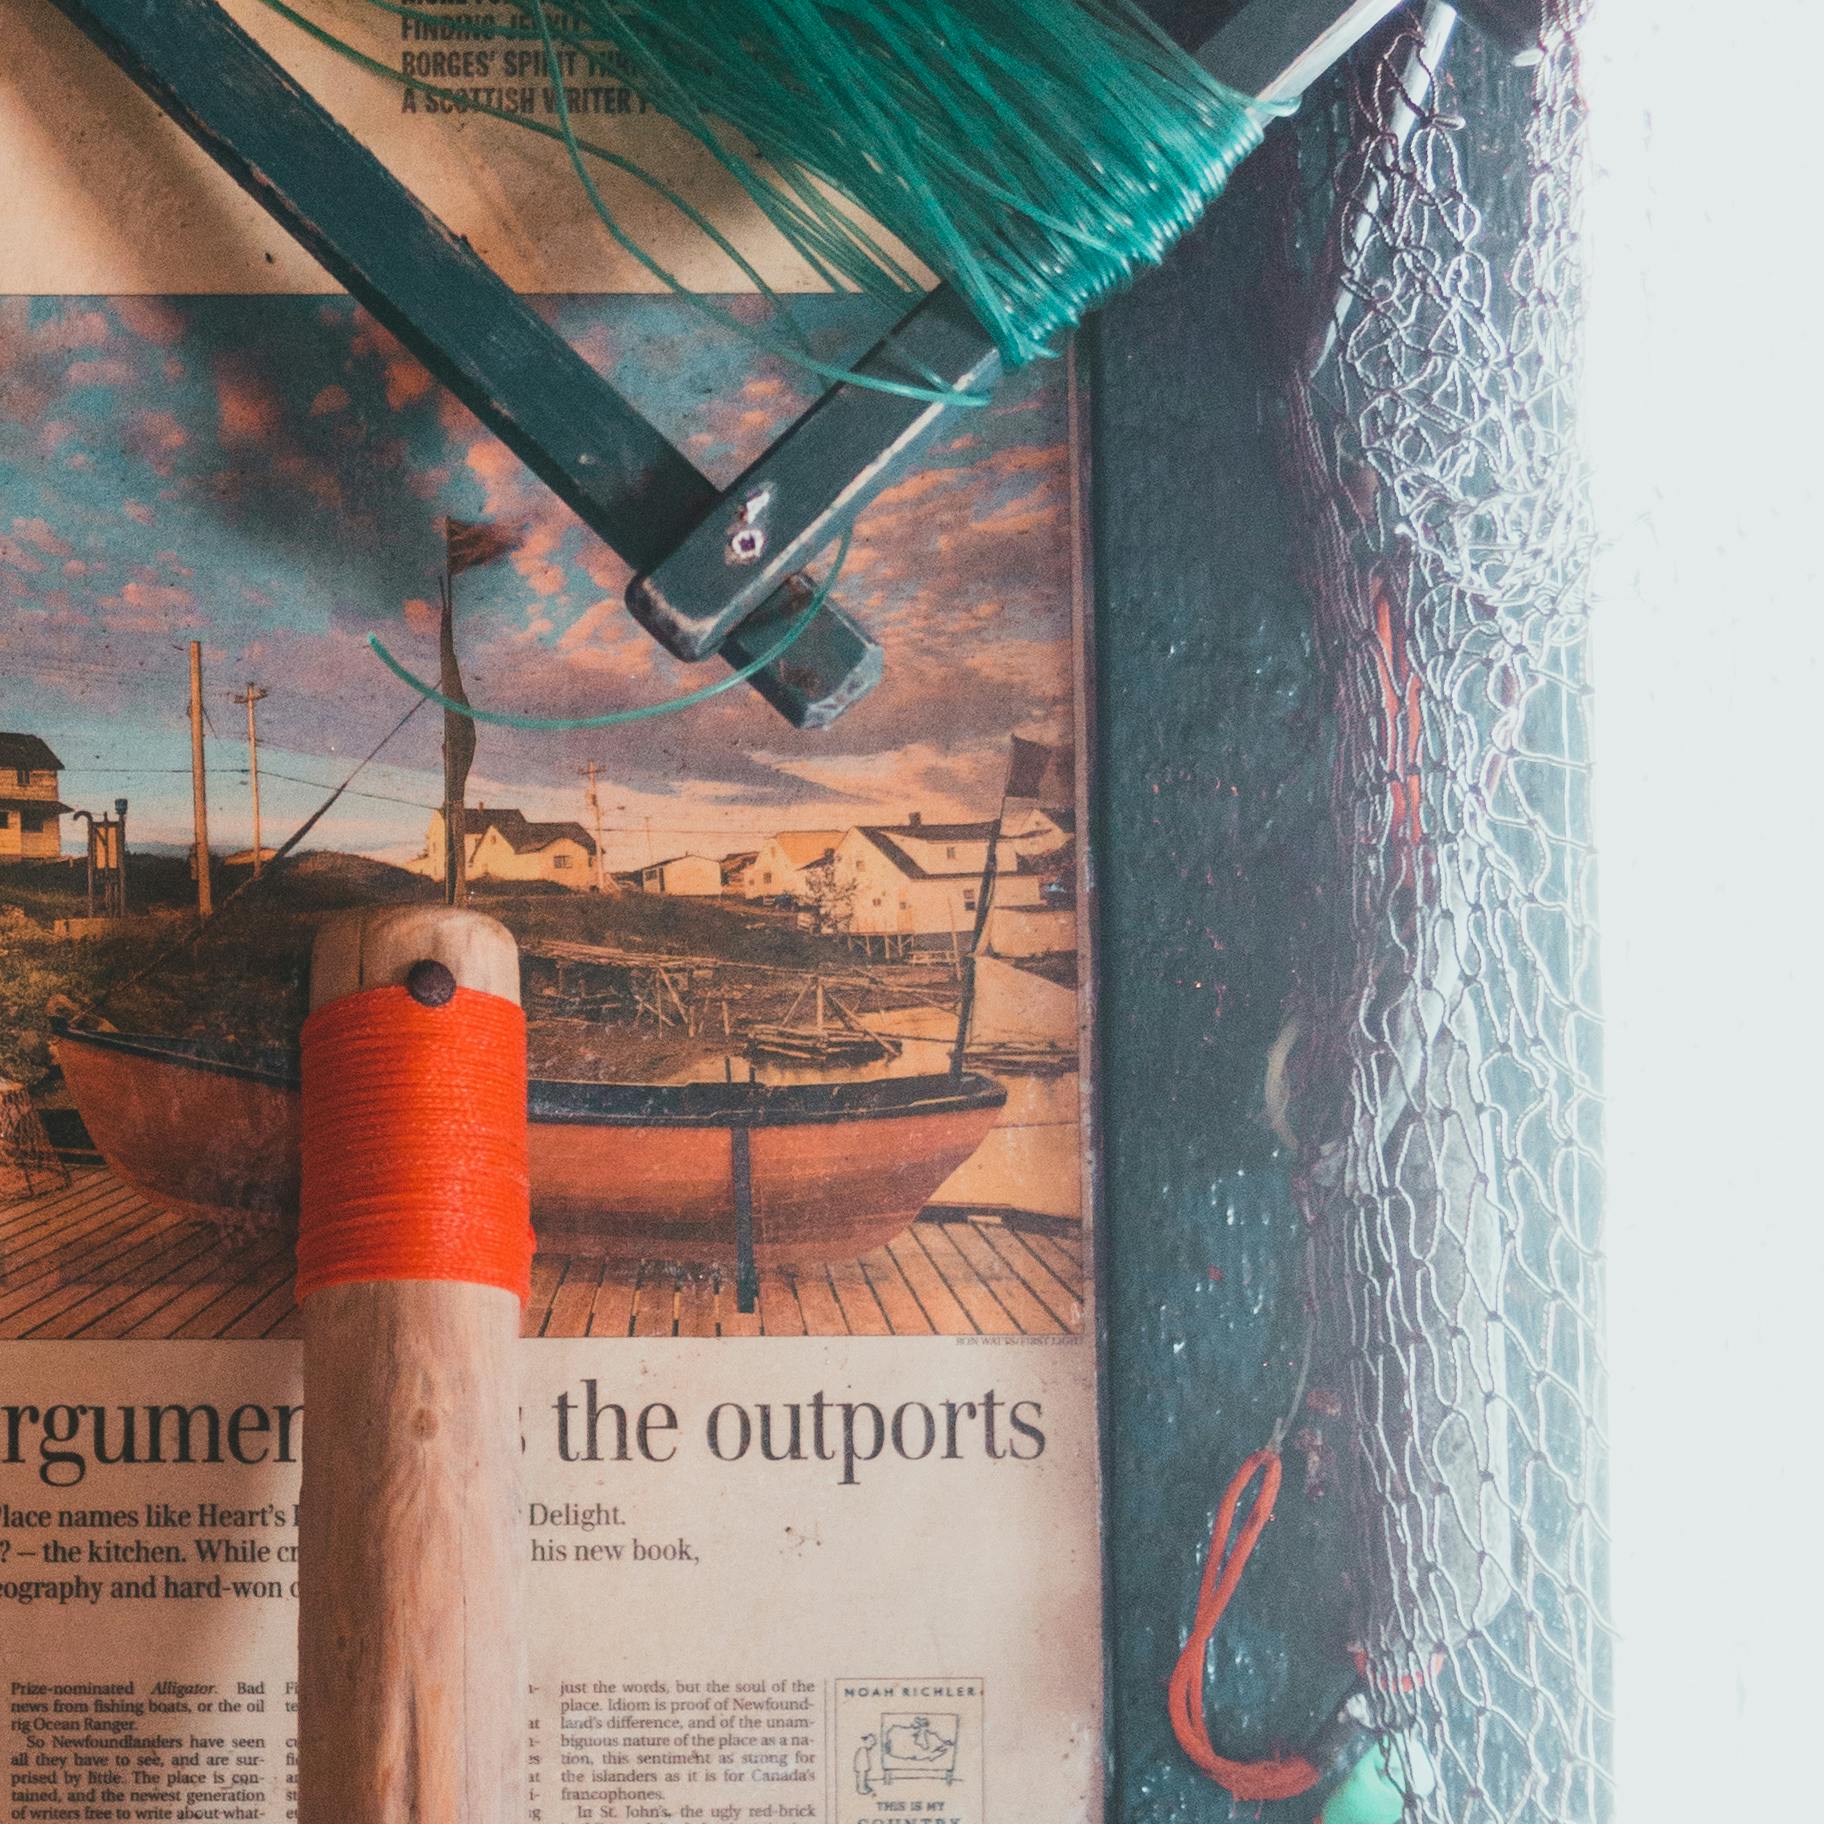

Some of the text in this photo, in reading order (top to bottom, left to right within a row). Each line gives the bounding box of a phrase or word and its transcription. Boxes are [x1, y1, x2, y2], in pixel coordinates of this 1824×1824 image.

[401, 50, 496, 77] BORGES’
[401, 88, 417, 114] A
[551, 1379, 678, 1462] the
[706, 1382, 1046, 1485] outports
[58, 1510, 139, 1527] names
[146, 1504, 191, 1527] like
[198, 1504, 285, 1527] Heart’s
[529, 1503, 625, 1530] Delight.
[43, 1540, 81, 1563] the
[88, 1540, 186, 1563] kitchen.
[194, 1539, 270, 1563] While
[531, 1539, 567, 1562] his
[575, 1545, 624, 1561] new
[633, 1538, 699, 1564] book,
[111, 1575, 156, 1598] and
[164, 1575, 282, 1598] hard-won
[560, 1679, 815, 1697] just the words, but the soul of the
[27, 1734, 265, 1749] So Newfoundlanders have seen
